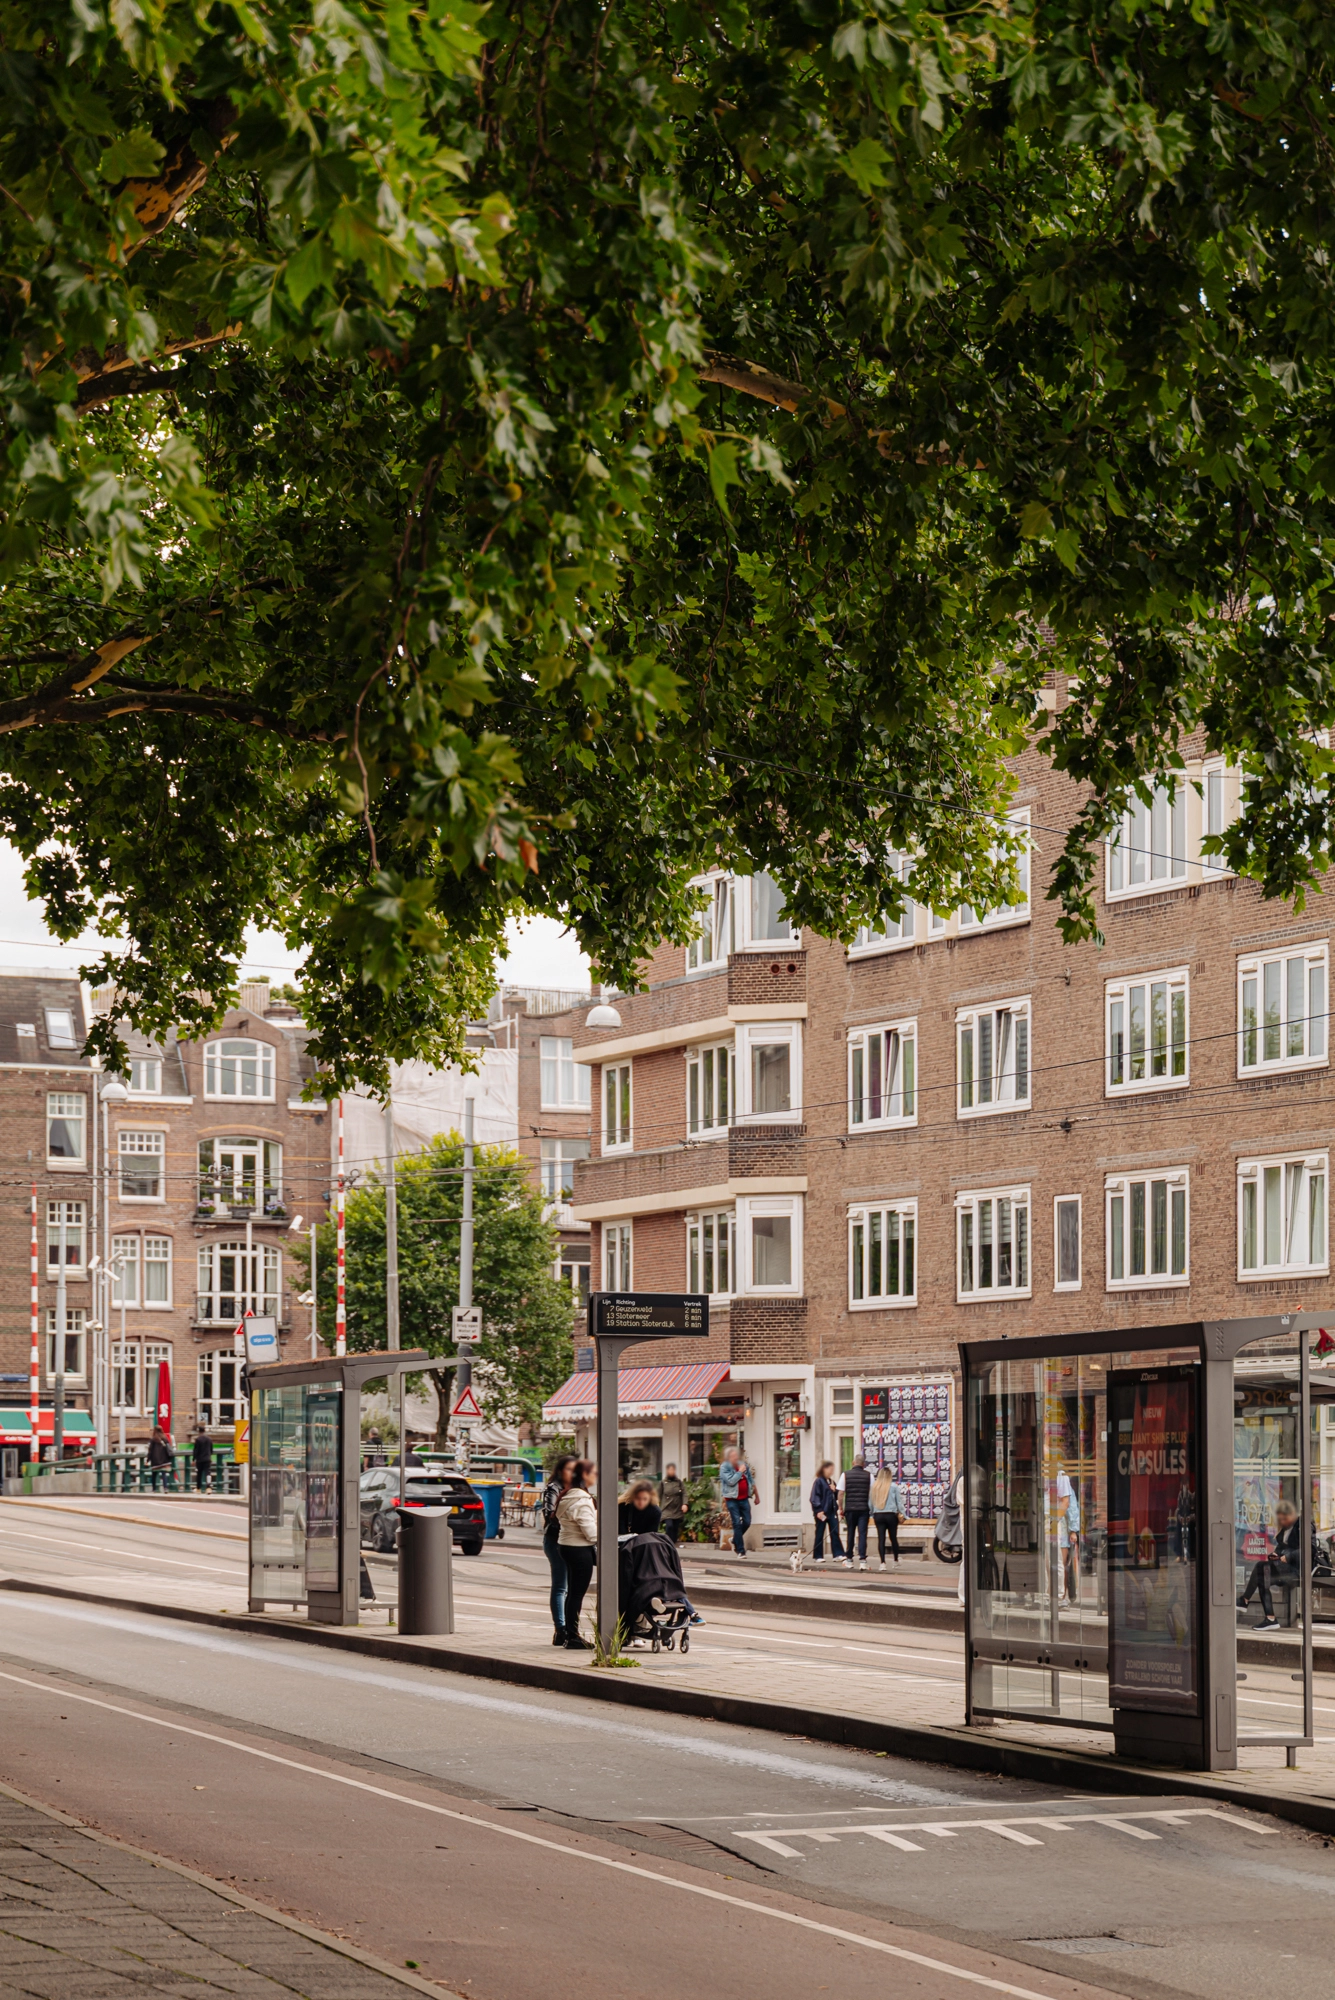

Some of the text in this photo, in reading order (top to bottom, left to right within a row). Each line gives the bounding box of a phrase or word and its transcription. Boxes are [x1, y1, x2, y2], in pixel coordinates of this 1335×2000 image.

[642, 1320, 675, 1328] Sloterdijk
[1143, 1407, 1162, 1418] NIEUW
[1119, 1431, 1187, 1444] BRILLIANT SHINE PLUS
[1117, 1449, 1187, 1476] CAPSULES
[1248, 1537, 1265, 1546] LAATSTE
[1246, 1547, 1268, 1555] MAANDEN
[1125, 1659, 1182, 1673] ZONDER VOORSPOELEN
[1124, 1670, 1183, 1685] STRALEND SCHONE VAAT
